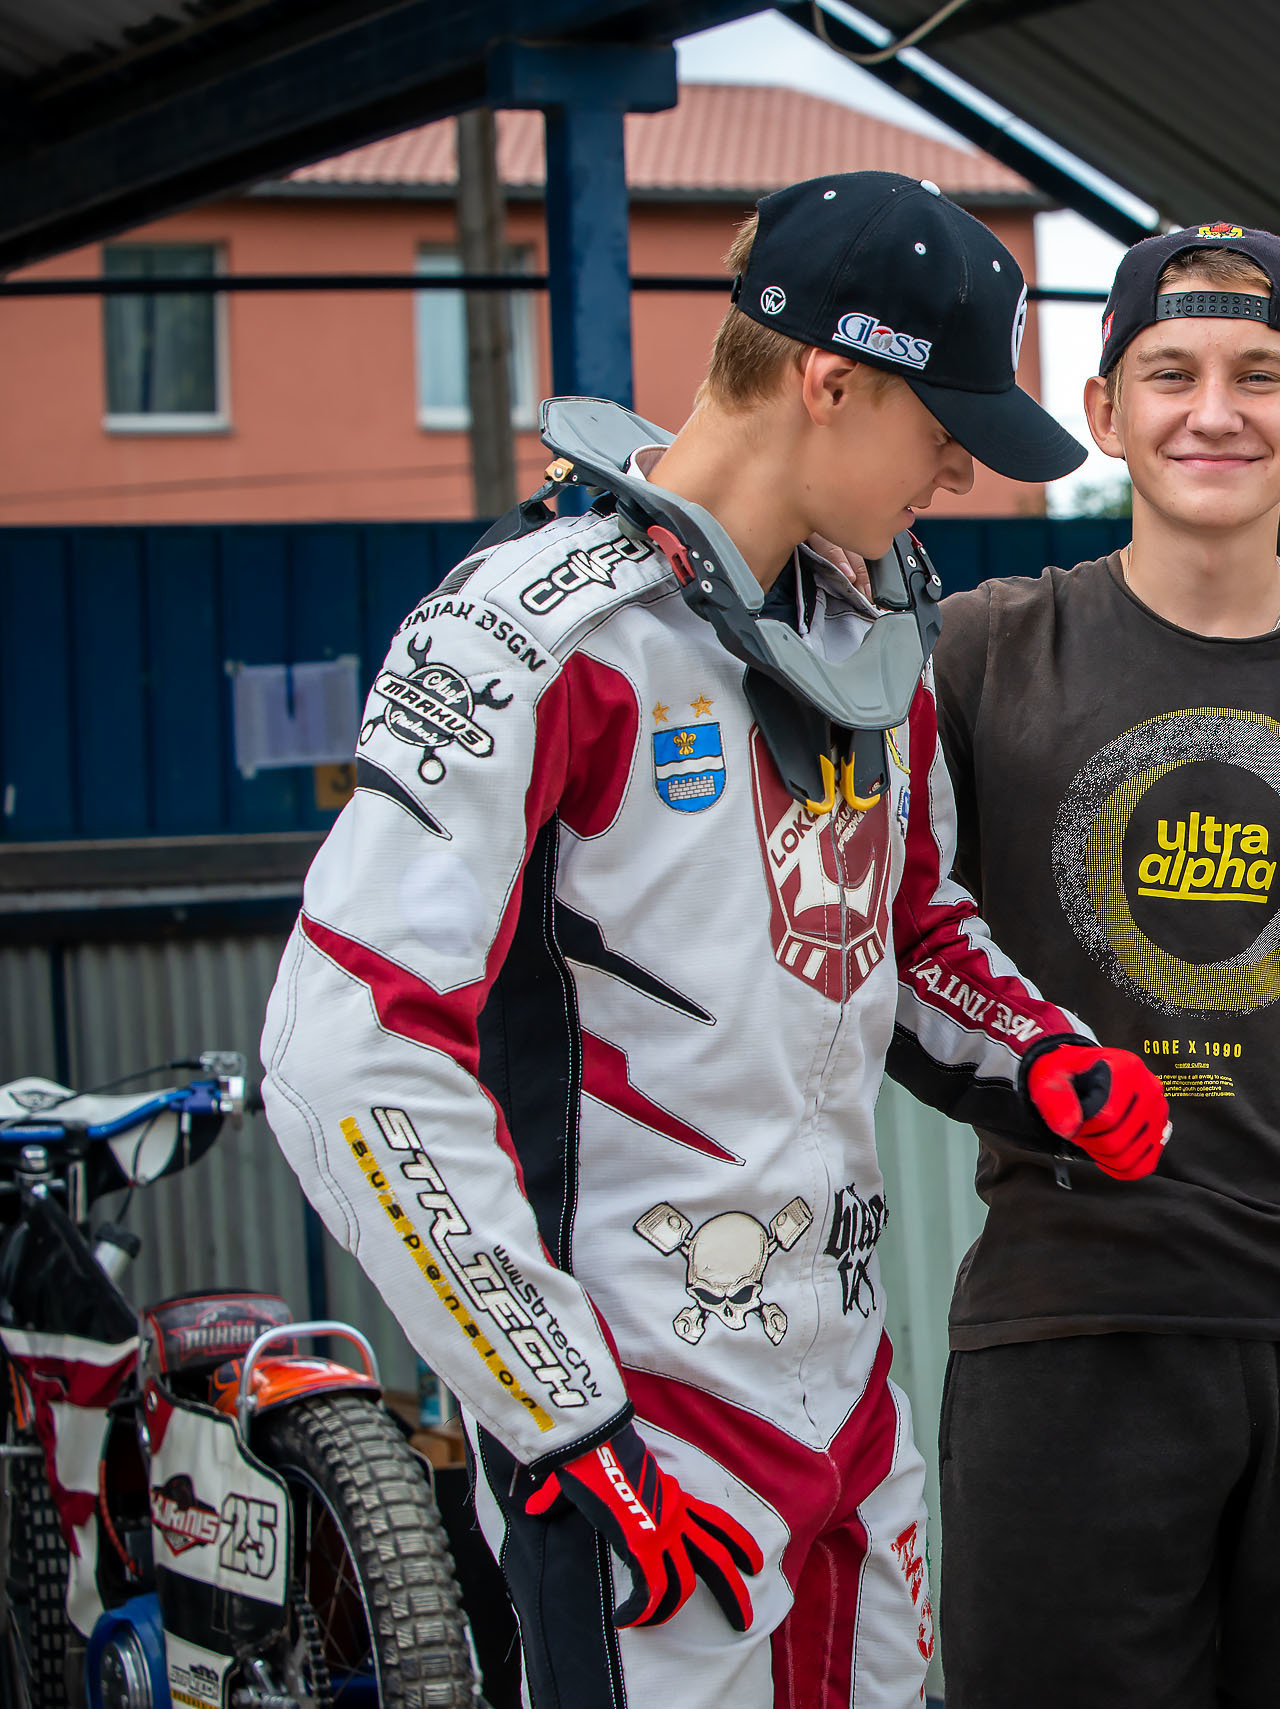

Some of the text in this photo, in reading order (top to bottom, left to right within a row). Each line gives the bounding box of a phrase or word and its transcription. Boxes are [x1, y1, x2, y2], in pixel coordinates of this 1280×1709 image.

[838, 313, 932, 363] Gloss
[383, 680, 483, 746] MARKUS
[1157, 812, 1268, 855] ultra
[1137, 848, 1277, 893] alpha
[1143, 1039, 1242, 1058] CORE X 1990
[351, 1138, 538, 1410] suspension
[371, 1106, 589, 1408] STRTECH
[595, 1446, 657, 1532] SCOTT
[219, 1492, 278, 1581] 25
